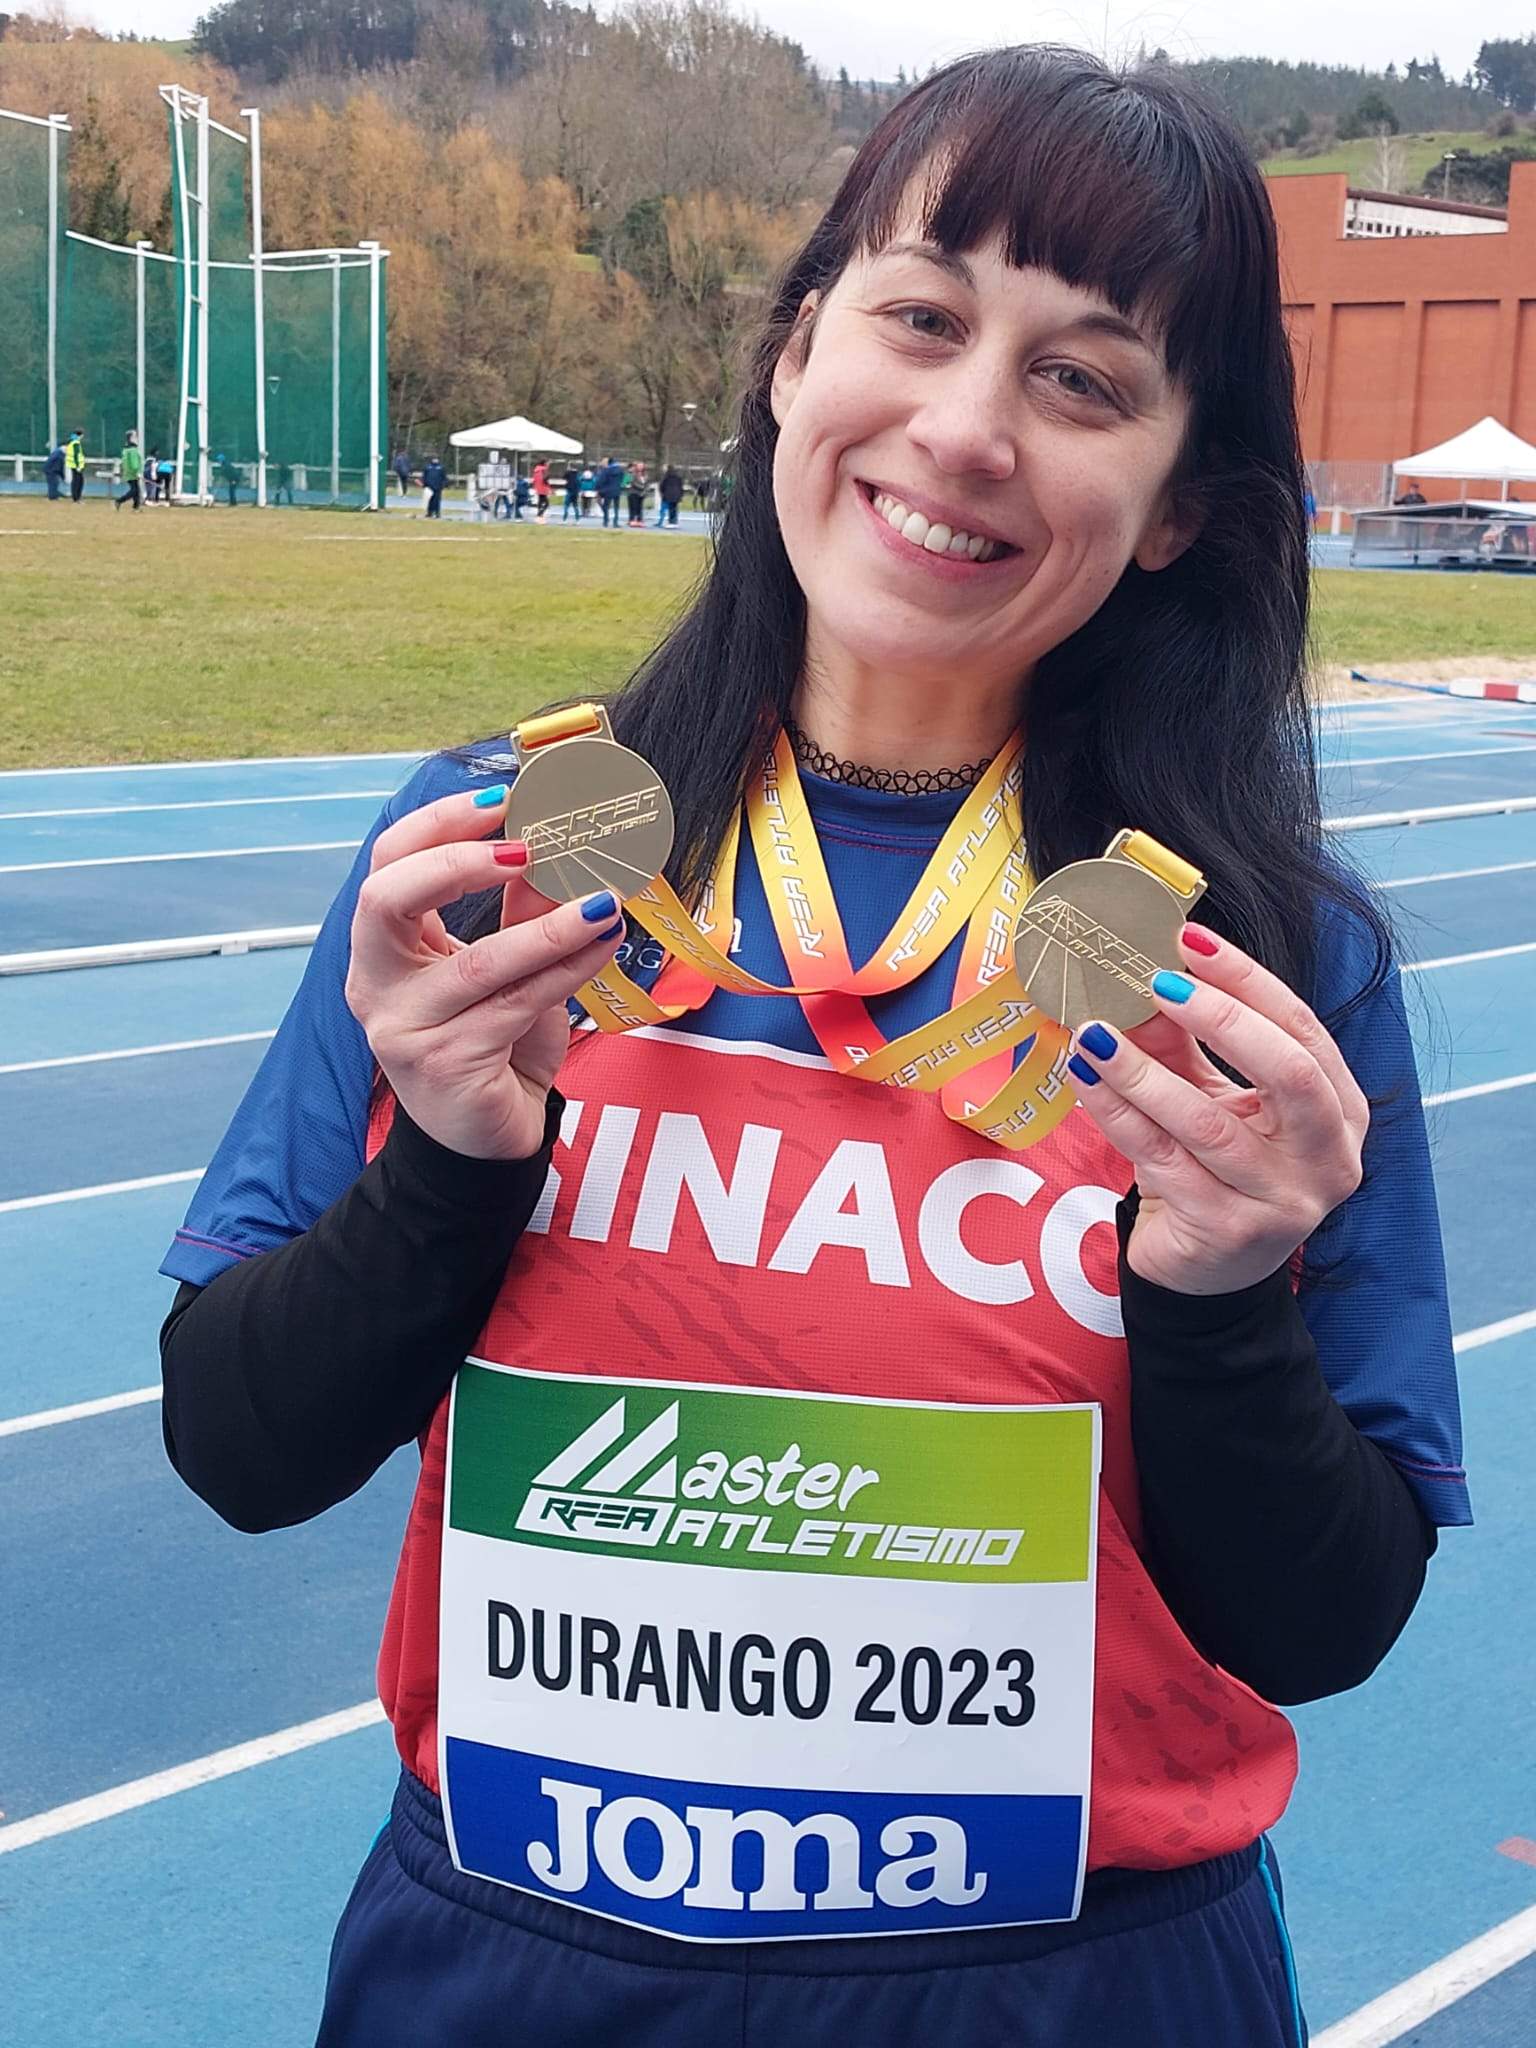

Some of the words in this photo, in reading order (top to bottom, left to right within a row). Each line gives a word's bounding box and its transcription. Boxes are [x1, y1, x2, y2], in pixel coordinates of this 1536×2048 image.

[782, 876, 825, 959] RFEA
[886, 886, 950, 972] RFEA
[539, 1496, 656, 1533] RFEA
[665, 1508, 1025, 1566] ATLETISMO
[486, 1599, 832, 1720] DURANGO
[853, 1642, 1037, 1728] 2023
